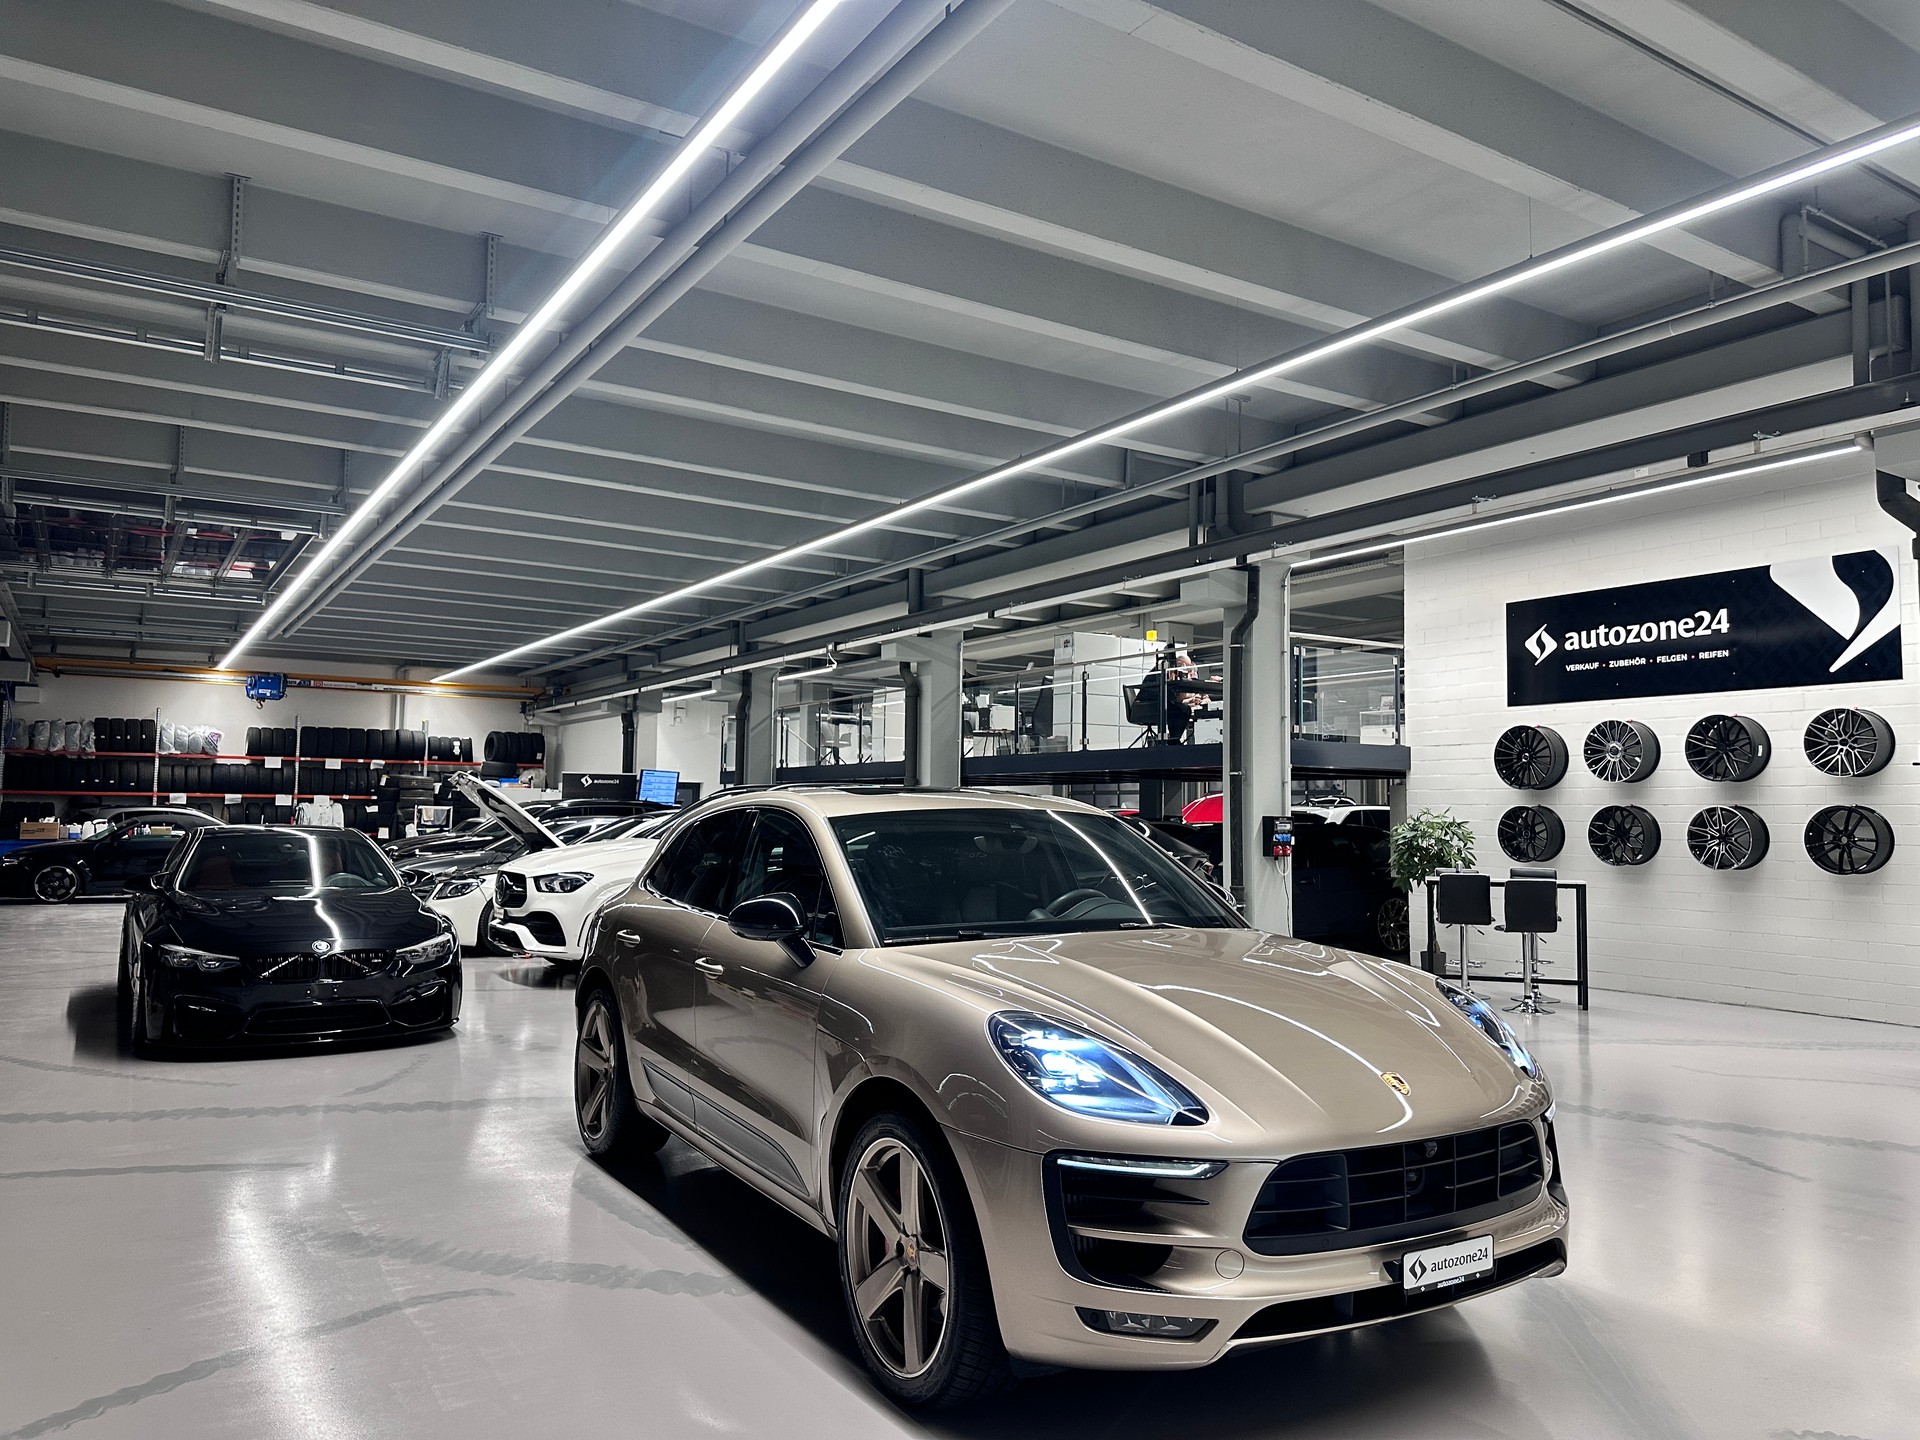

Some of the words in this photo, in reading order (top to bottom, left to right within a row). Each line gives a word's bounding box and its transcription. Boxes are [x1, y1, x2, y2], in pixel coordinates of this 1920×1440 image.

[1564, 608, 1730, 651] autozone24
[1565, 662, 1600, 672] VERKAUF
[1608, 656, 1647, 668] ZUBEHÖR
[1656, 653, 1688, 664] FELGEN
[1698, 650, 1730, 660] REIFEN
[1430, 1247, 1489, 1273] autozone24
[1436, 1275, 1466, 1289] autozone24
